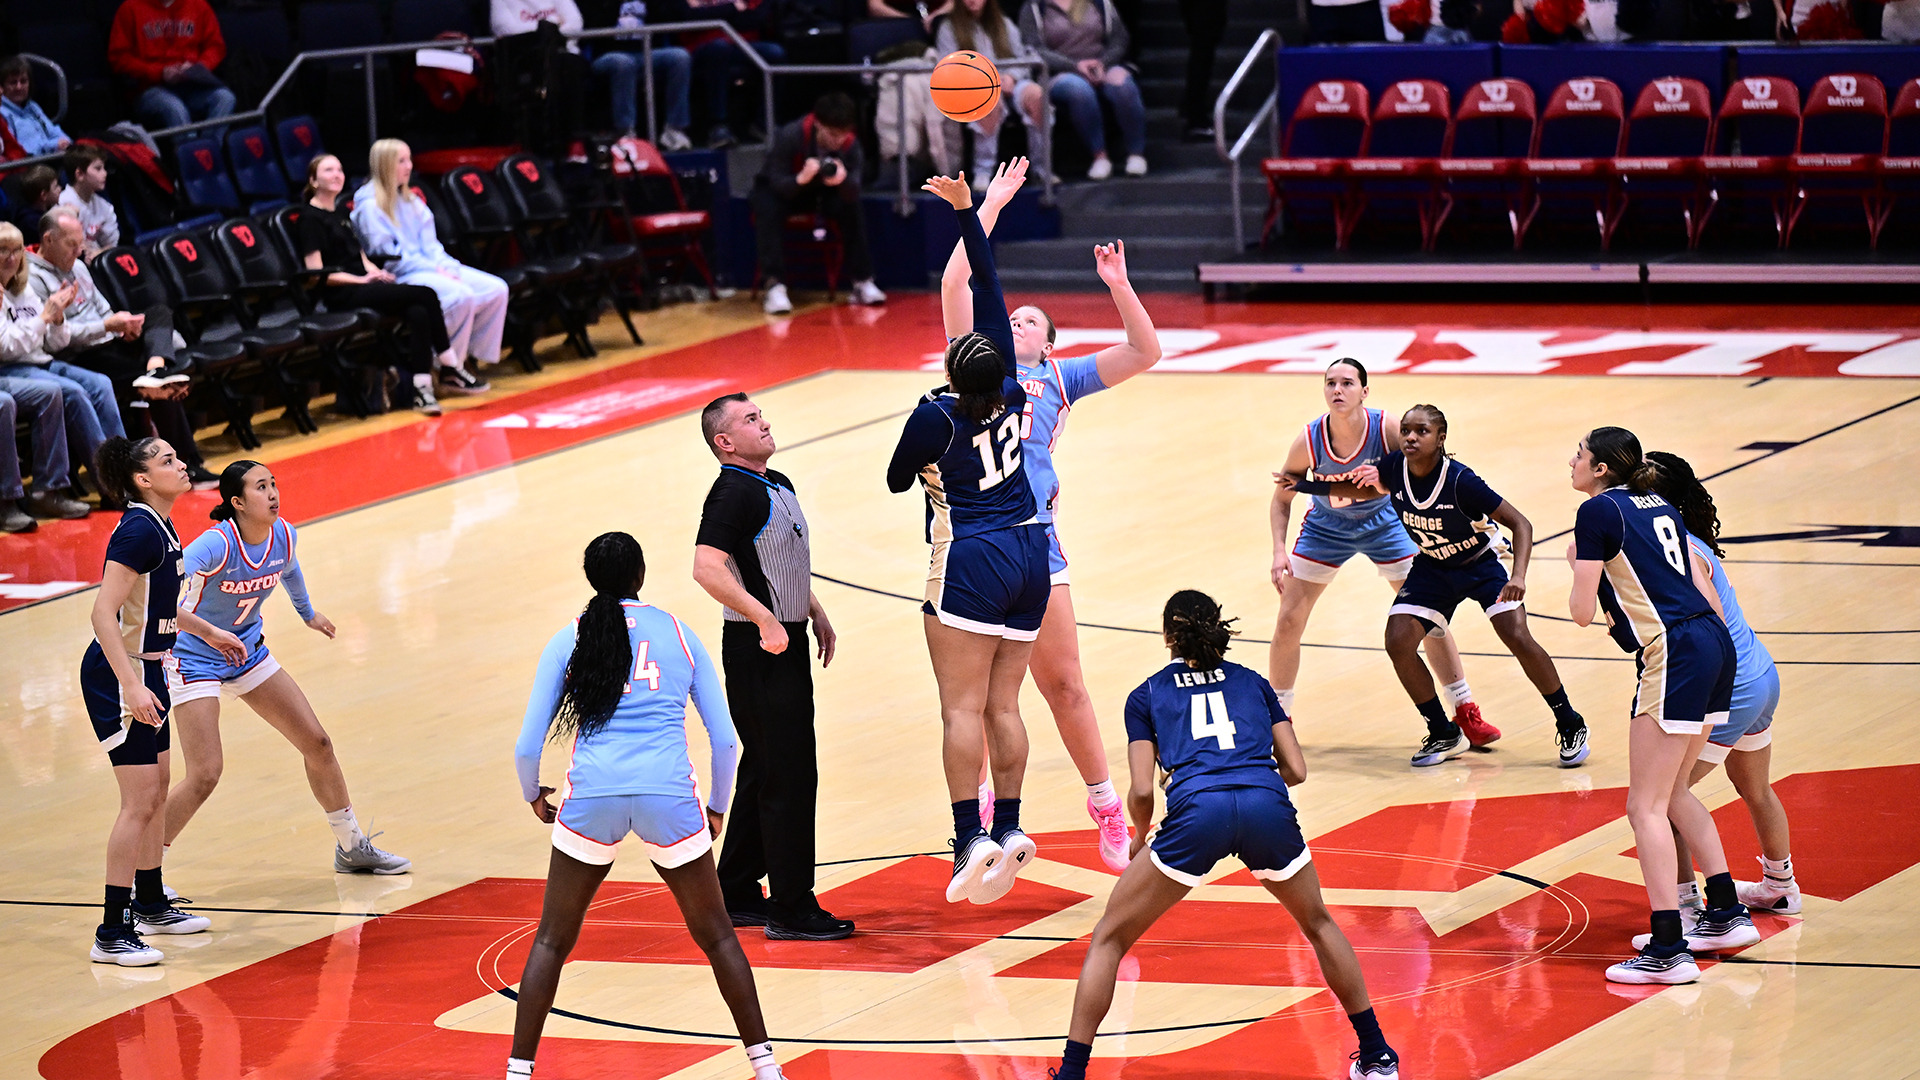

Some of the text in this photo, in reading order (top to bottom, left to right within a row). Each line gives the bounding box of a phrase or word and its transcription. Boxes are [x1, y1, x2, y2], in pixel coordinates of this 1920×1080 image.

[1742, 99, 1778, 110] DAYTON
[1827, 96, 1864, 107] DAYTON
[972, 412, 1021, 491] 12
[1402, 510, 1443, 531] GEORGE
[1412, 528, 1450, 548] 11
[1652, 514, 1686, 576] 8
[218, 569, 283, 595] DAYTON
[232, 596, 260, 626] 7
[1173, 668, 1227, 688] LEWIS
[1191, 691, 1237, 750] 4
